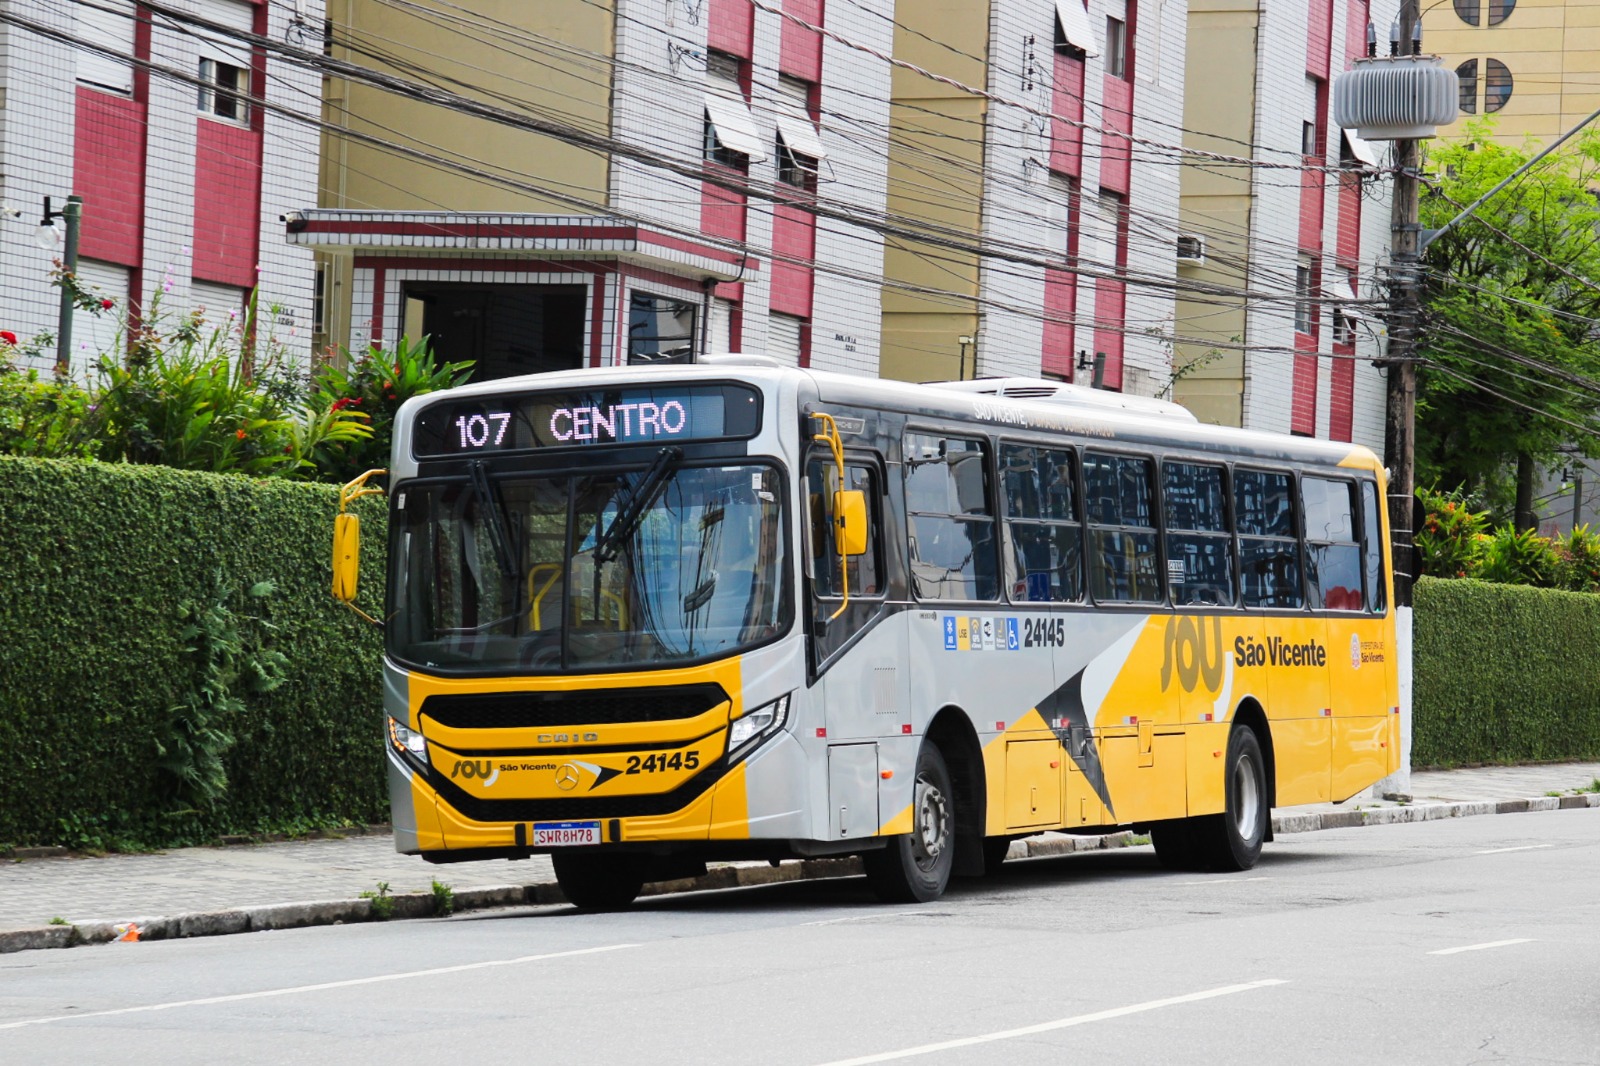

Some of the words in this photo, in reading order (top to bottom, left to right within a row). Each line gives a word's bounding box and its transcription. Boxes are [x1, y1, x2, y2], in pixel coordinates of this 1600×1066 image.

[456, 412, 511, 448] 107
[550, 401, 686, 441] CENTRO
[959, 629, 967, 638] USB
[1024, 617, 1065, 648] 24145
[1234, 635, 1266, 668] São
[1267, 636, 1326, 667] Vicente
[537, 731, 599, 743] CAIO
[520, 763, 557, 771] Vicente
[625, 750, 700, 775] 24145
[538, 829, 593, 843] SWR8H78
